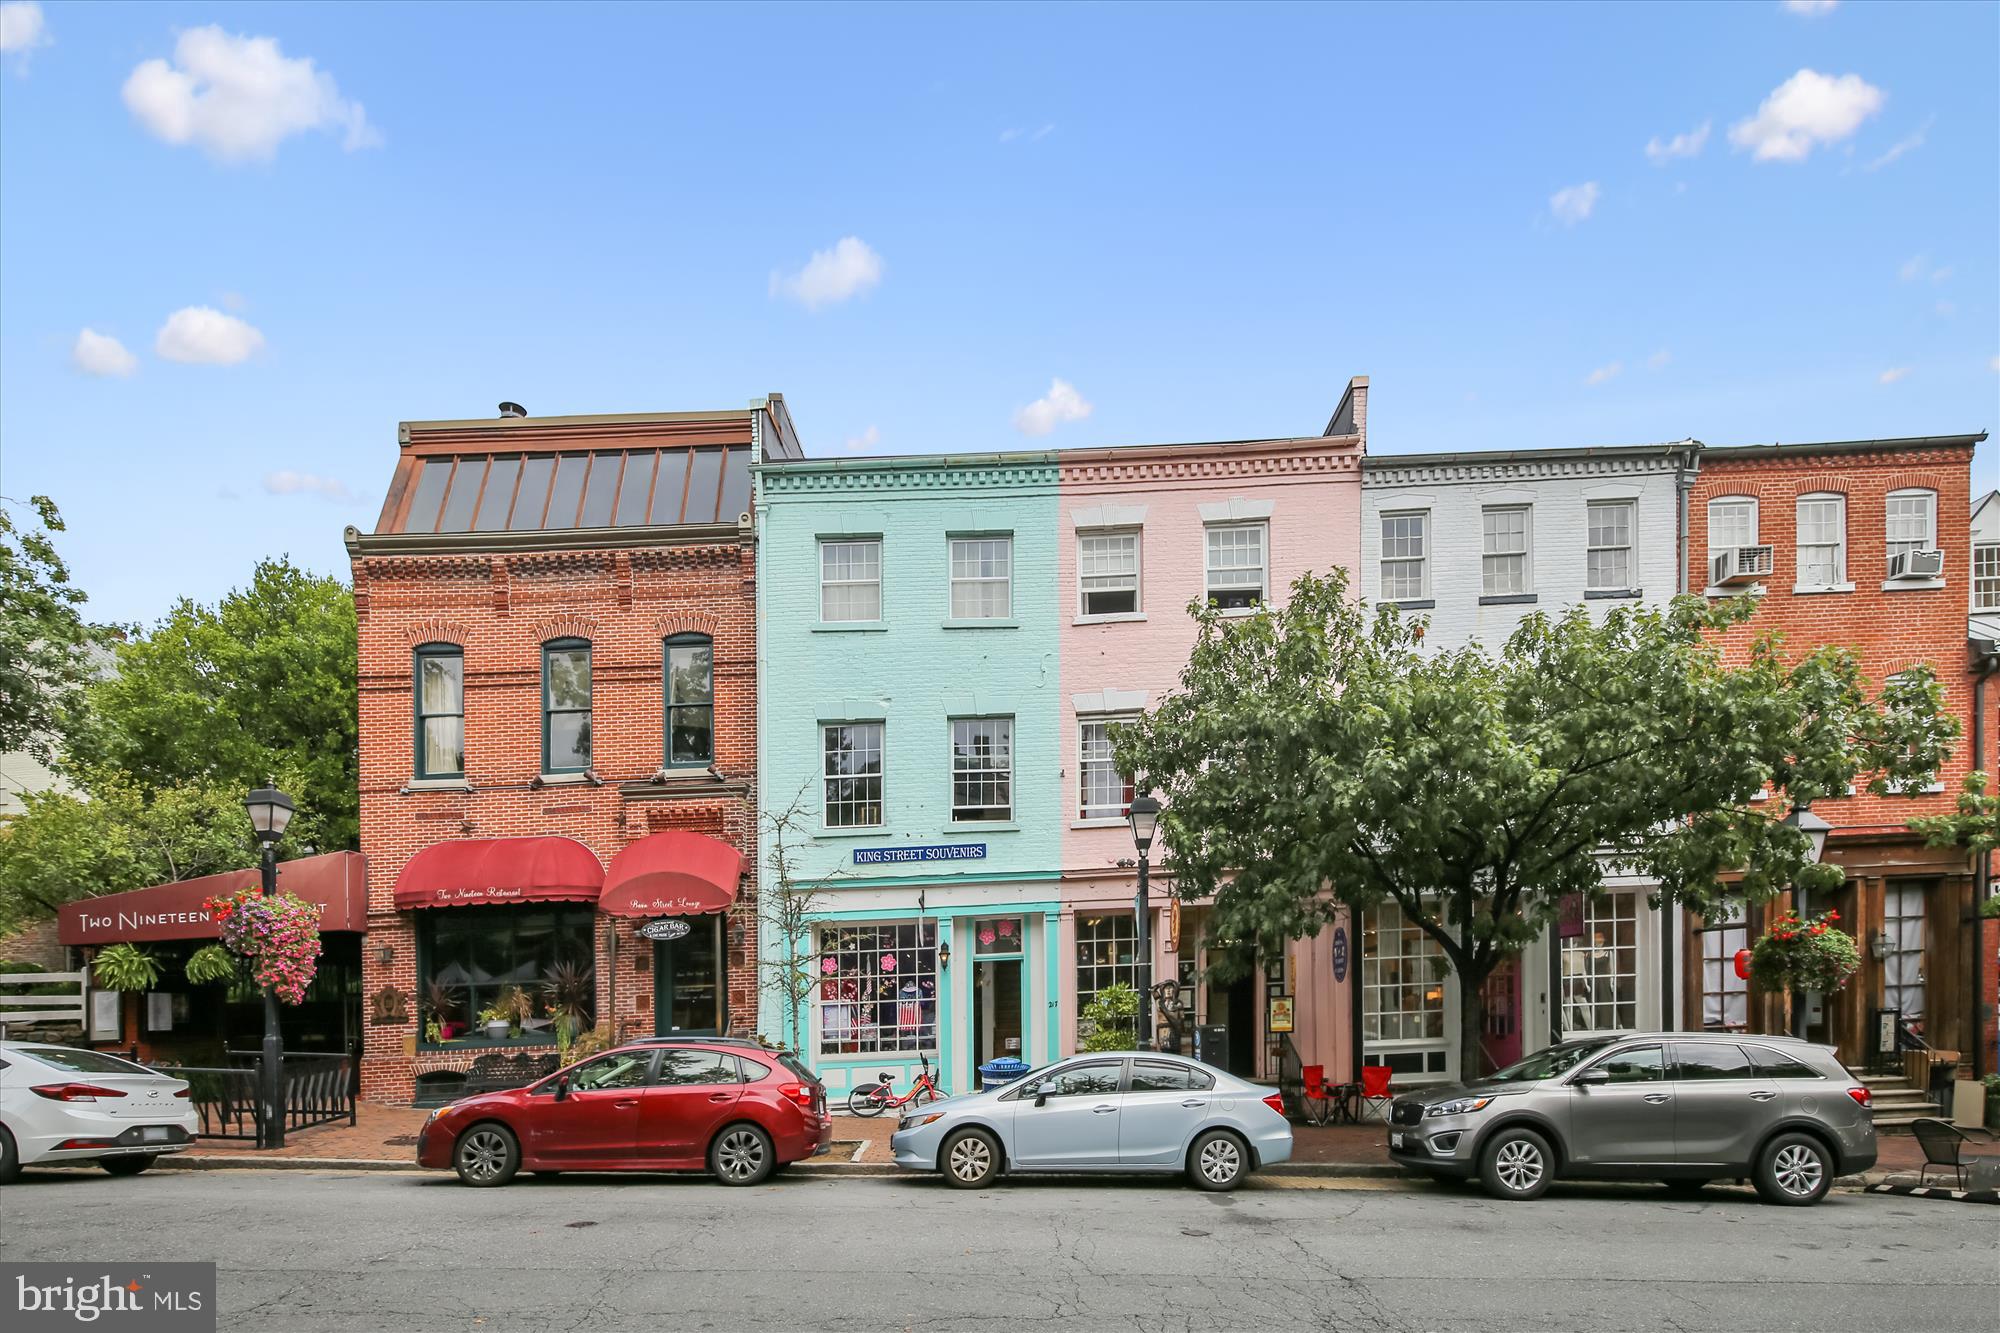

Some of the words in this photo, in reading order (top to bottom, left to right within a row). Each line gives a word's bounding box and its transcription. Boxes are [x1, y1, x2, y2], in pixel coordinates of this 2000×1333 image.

[856, 851, 881, 863] KING
[883, 849, 924, 862] STREET
[926, 846, 983, 860] SOUVENIRS
[437, 888, 452, 899] Two
[652, 898, 673, 909] Street
[79, 914, 112, 932] TWO
[119, 911, 210, 930] NINETEEN
[647, 924, 669, 934] CIGAR
[669, 923, 685, 931] BAR
